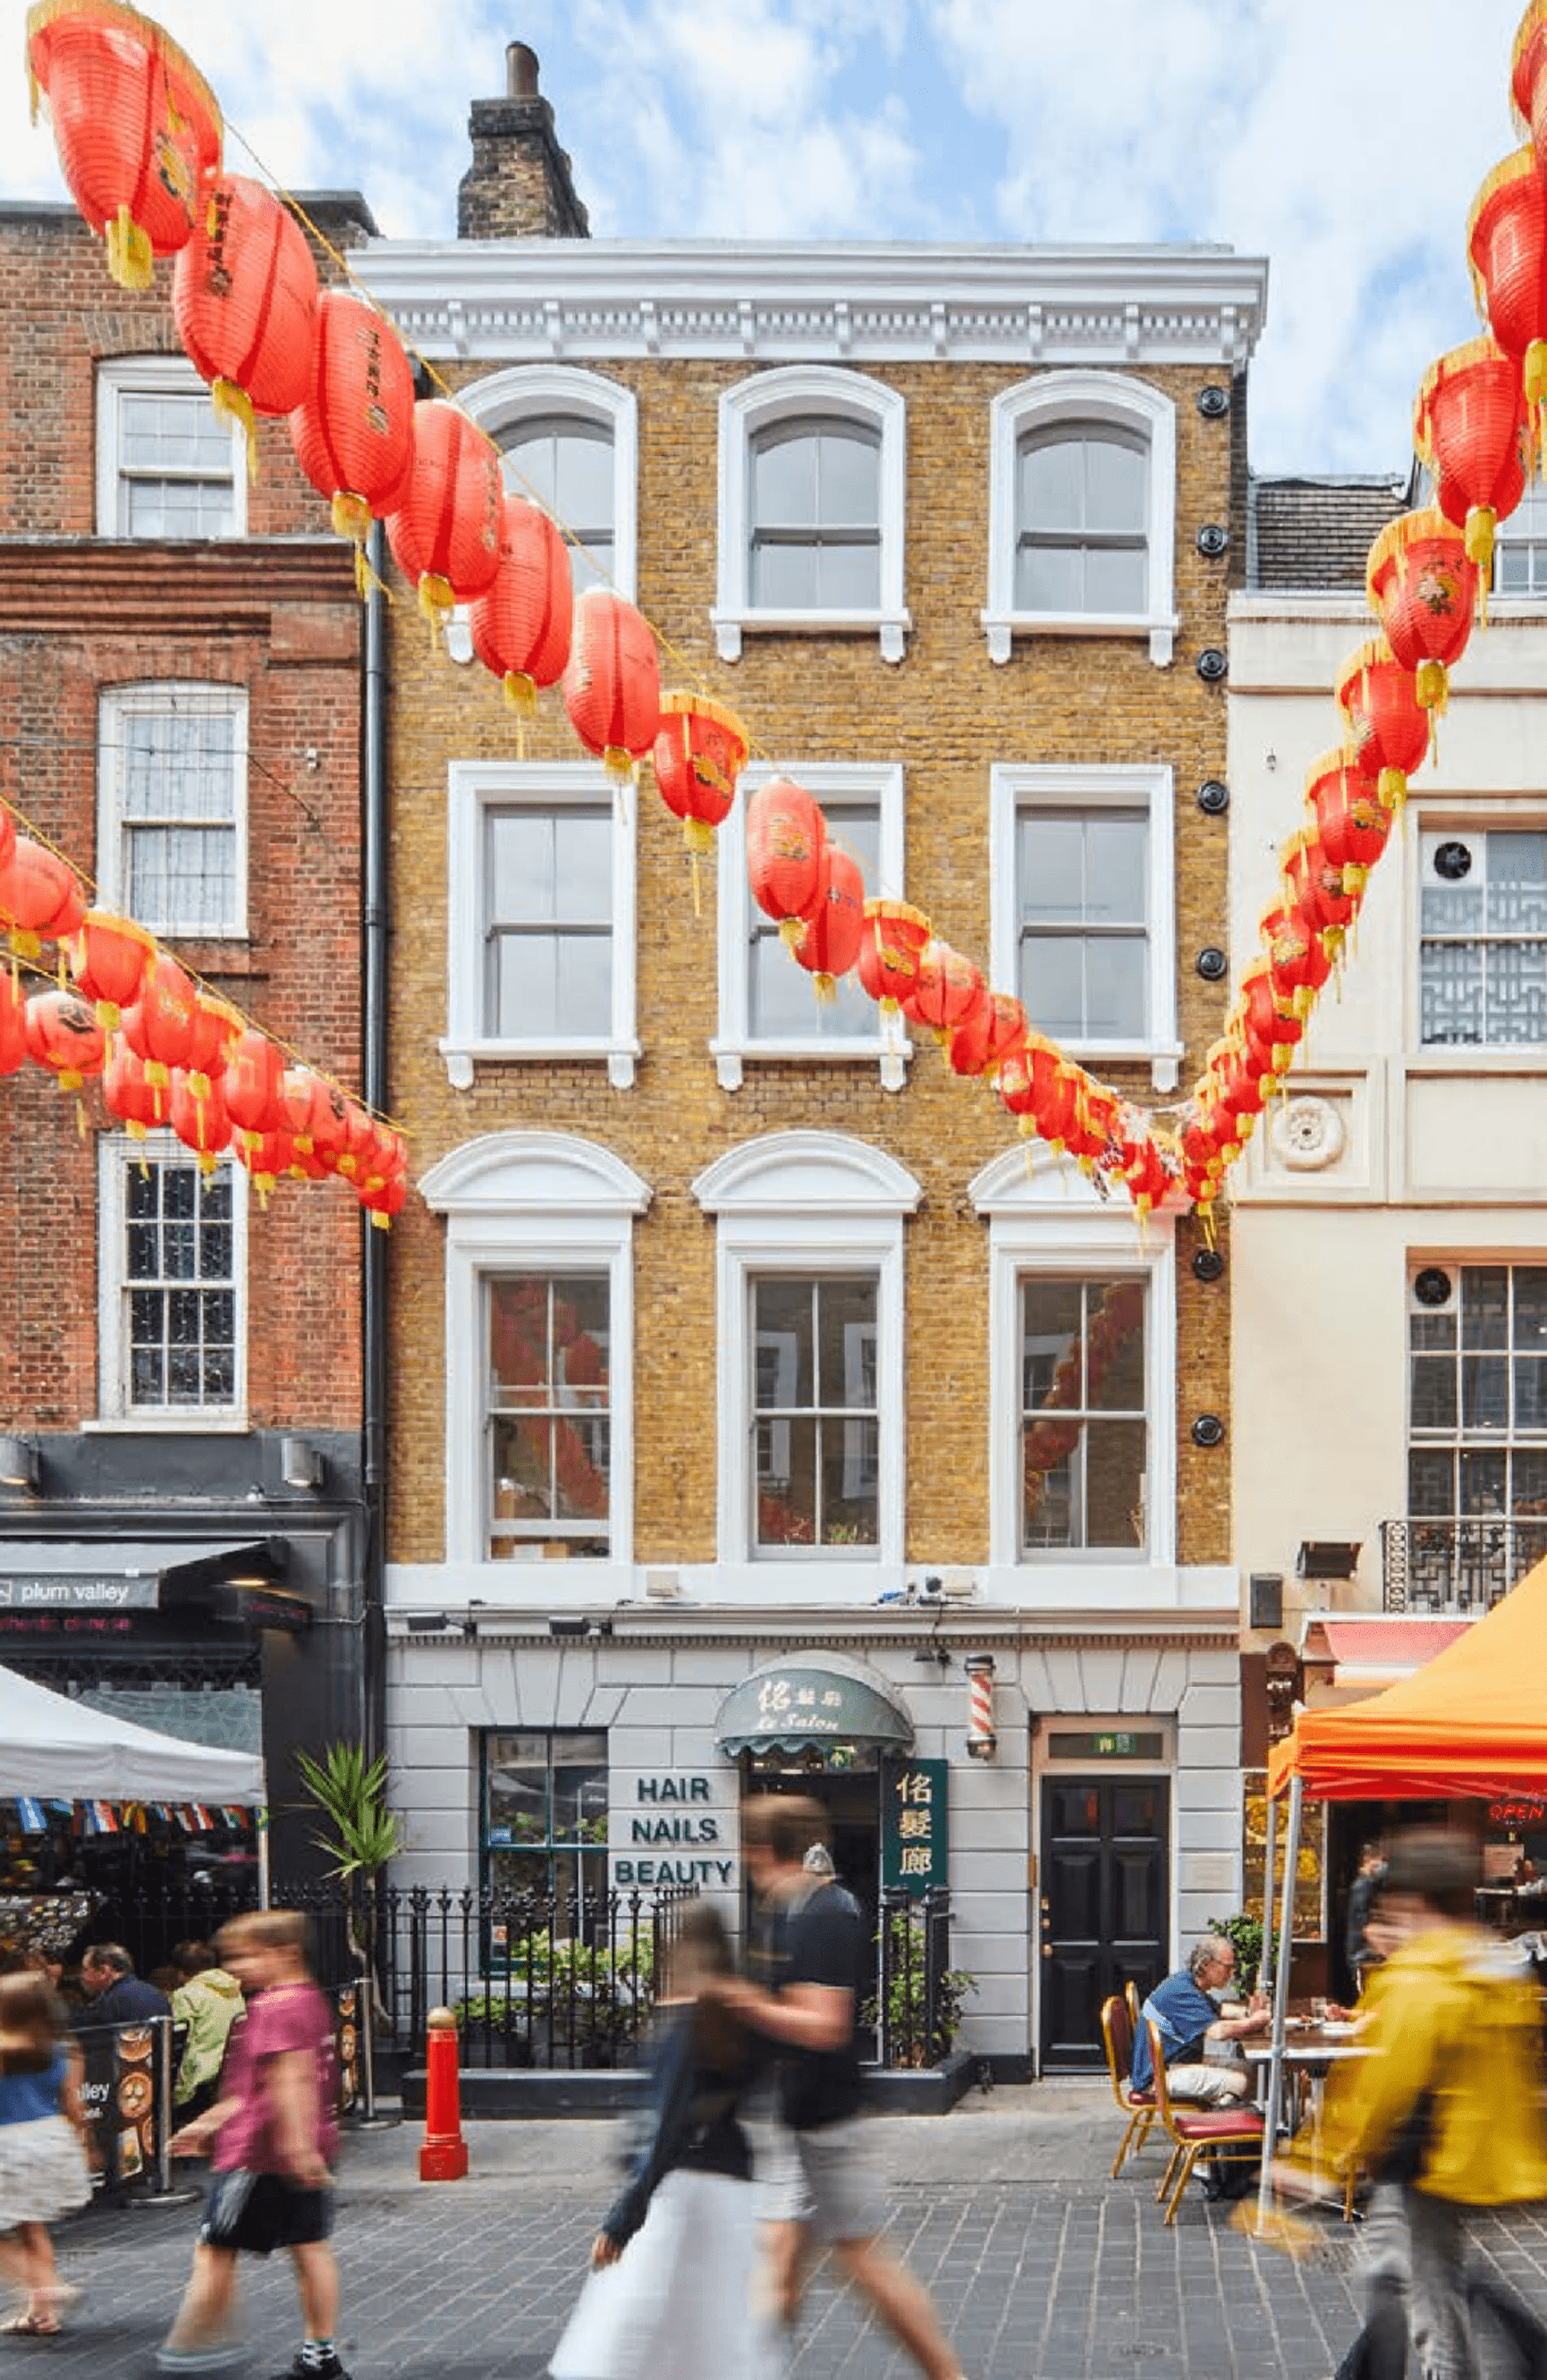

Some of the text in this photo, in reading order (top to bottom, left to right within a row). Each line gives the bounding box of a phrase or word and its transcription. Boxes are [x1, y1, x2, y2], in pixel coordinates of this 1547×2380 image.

[22, 1582, 129, 1605] plum valley
[637, 1777, 709, 1802] HAIR
[1488, 1804, 1545, 1820] OPEN
[632, 1818, 718, 1842] NAILS
[614, 1860, 732, 1884] BEAUTY
